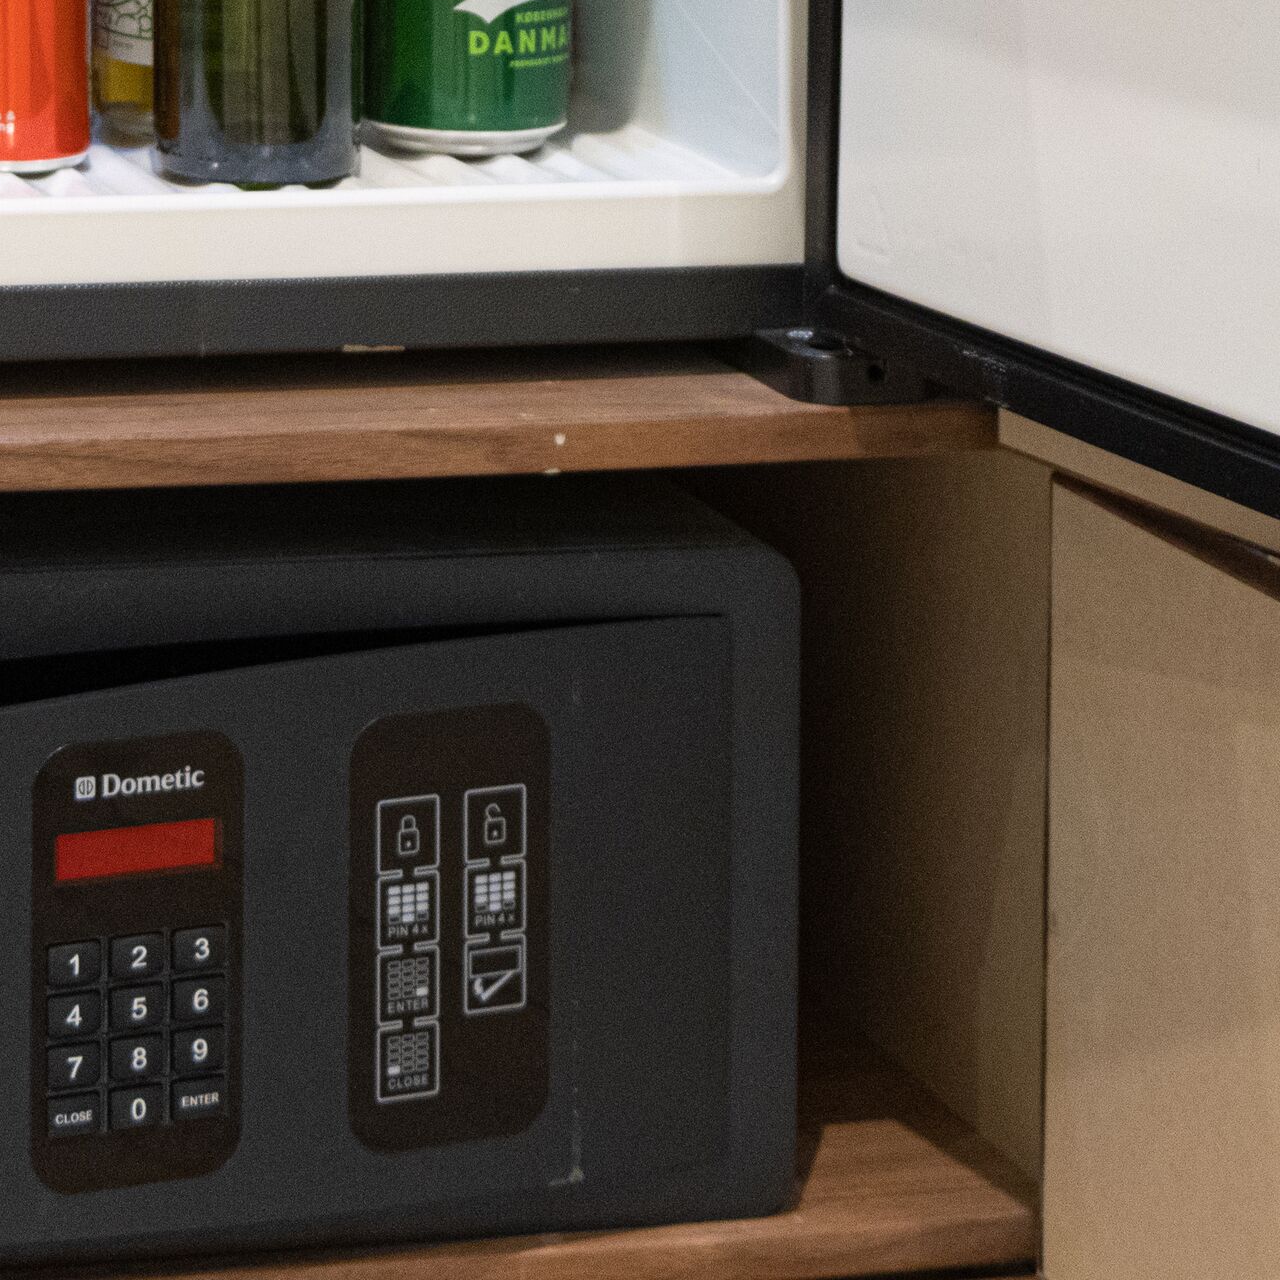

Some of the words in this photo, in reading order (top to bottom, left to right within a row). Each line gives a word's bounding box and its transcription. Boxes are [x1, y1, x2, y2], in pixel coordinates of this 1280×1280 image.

[102, 765, 206, 797] Dometic
[387, 926, 409, 938] PIN
[412, 923, 420, 934] 4
[474, 915, 495, 927] PIN
[498, 913, 506, 924] 4
[69, 953, 81, 976] 1
[131, 945, 148, 969] 2
[194, 937, 210, 961] 3
[66, 1003, 83, 1027] 4
[131, 996, 148, 1020] 5
[193, 988, 209, 1011] 6
[387, 998, 429, 1014] ENTER
[67, 1055, 84, 1079] 7
[131, 1046, 148, 1070] 8
[192, 1038, 208, 1061] 9
[388, 1075, 429, 1090] CLOSE
[54, 1109, 93, 1125] CLOSE
[131, 1097, 147, 1121] 0
[181, 1091, 220, 1108] ENTER
